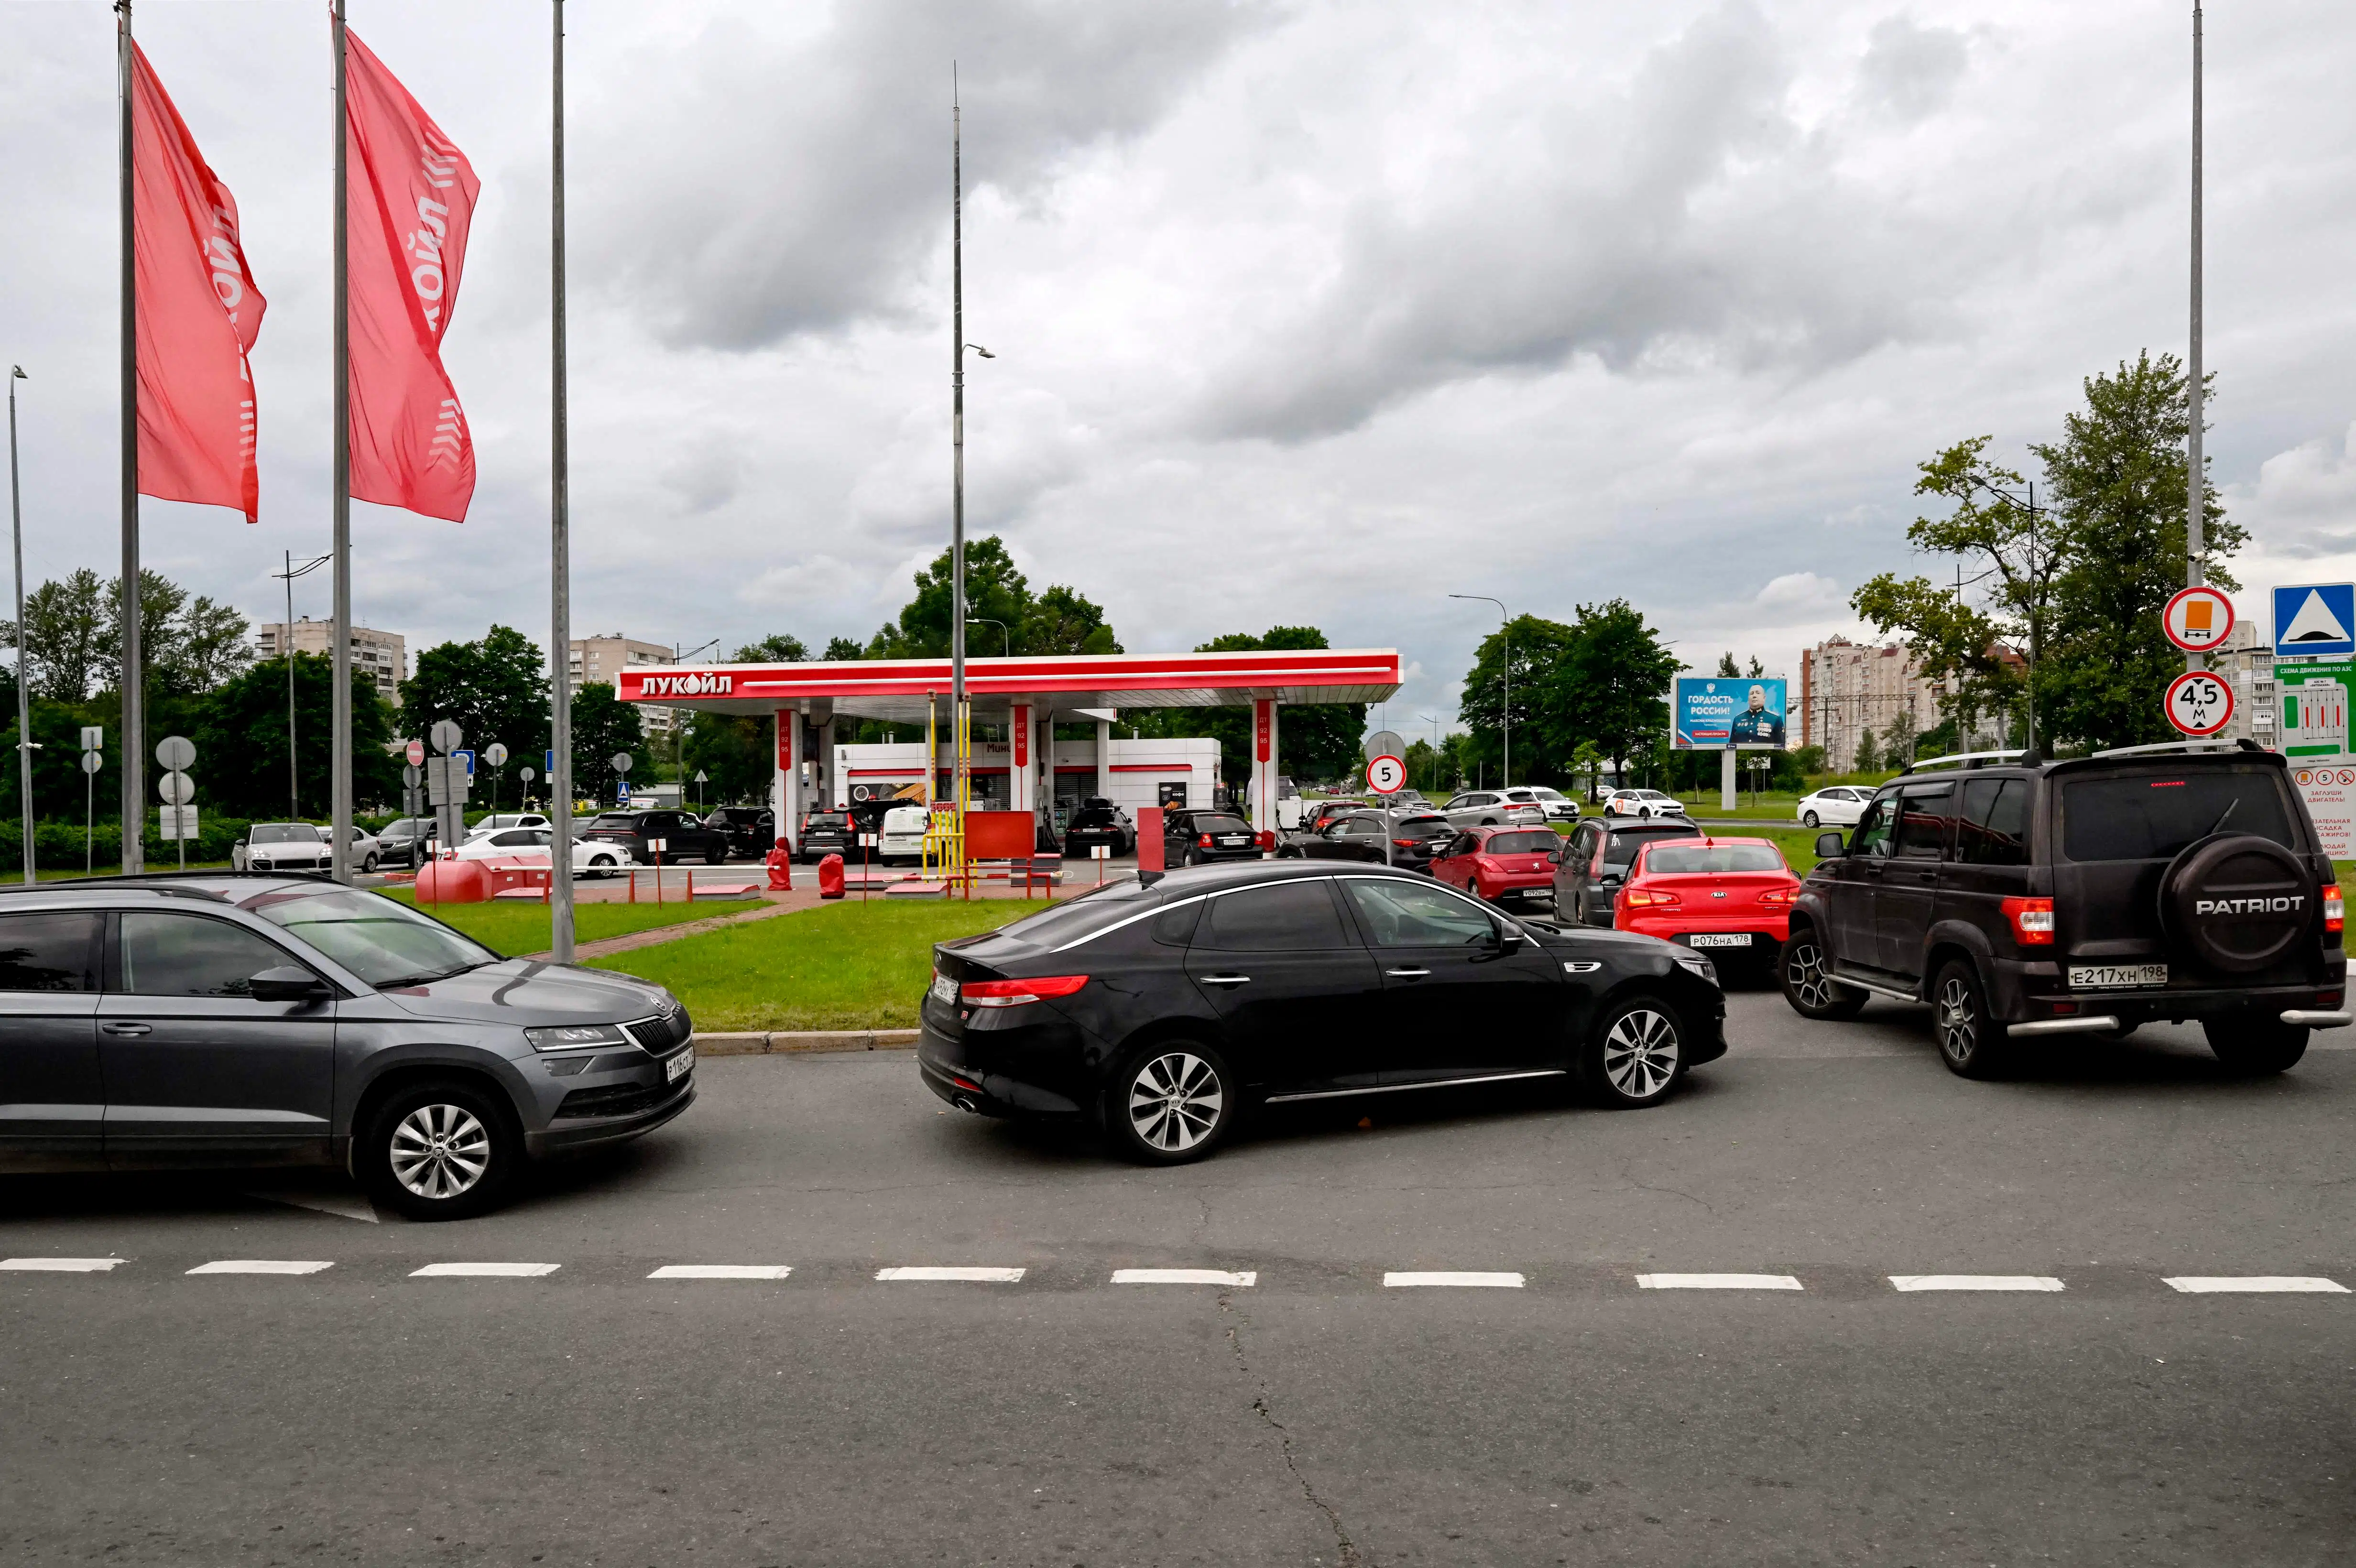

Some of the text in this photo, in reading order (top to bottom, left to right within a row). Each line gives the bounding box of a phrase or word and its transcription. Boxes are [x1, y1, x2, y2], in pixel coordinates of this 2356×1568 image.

[640, 672, 731, 695] ЛУКОЙЛ
[1688, 696, 1734, 705] ГОРДОСТЬ
[2180, 684, 2217, 708] 4,5
[1691, 707, 1730, 715] РОССИИ!
[1382, 767, 1391, 782] 5
[2196, 896, 2304, 915] PATRIOT
[1694, 936, 1732, 945] Р076НА
[2074, 966, 2163, 983] Е217ХН 198
